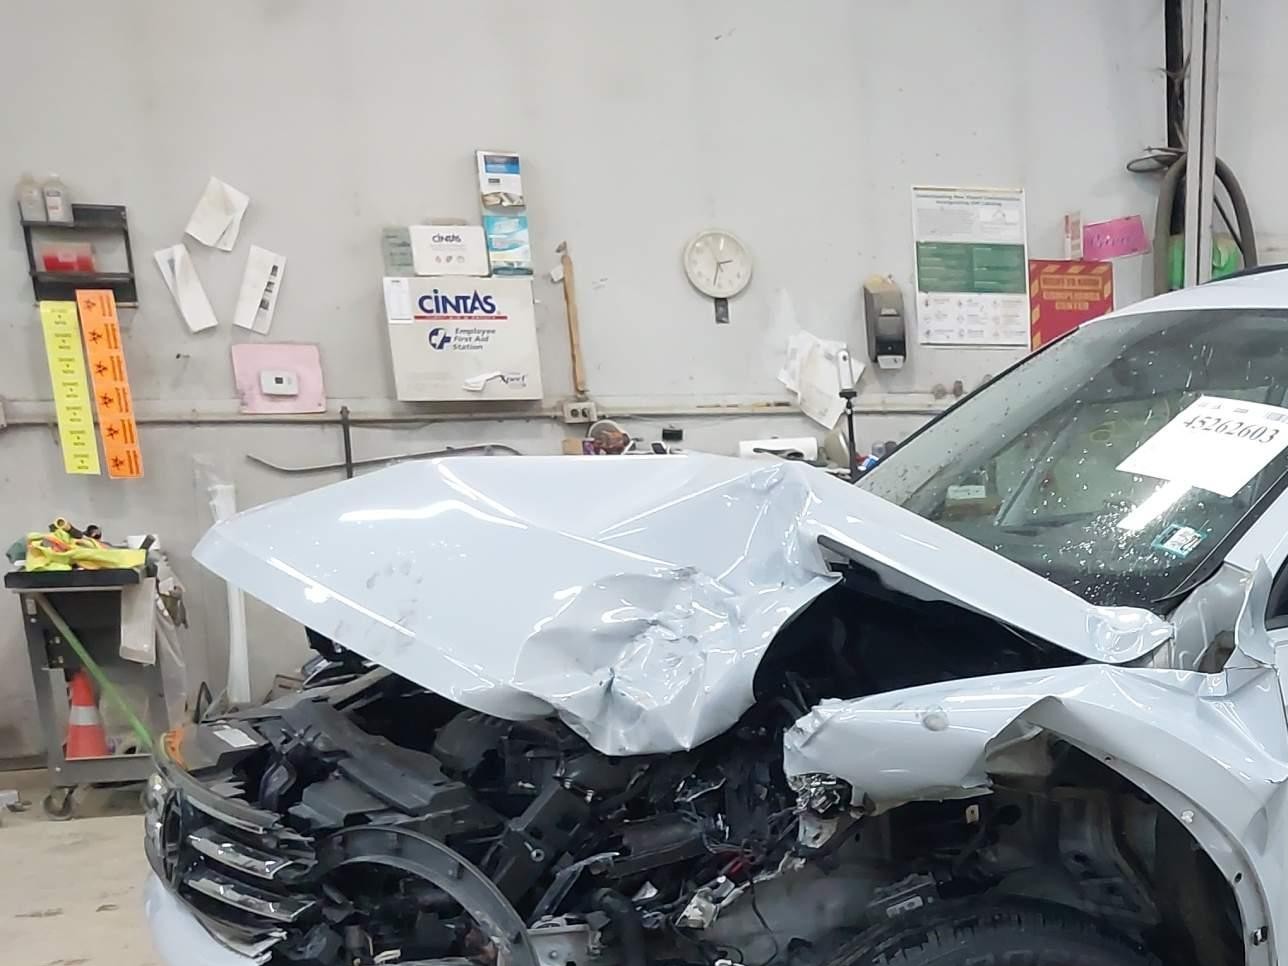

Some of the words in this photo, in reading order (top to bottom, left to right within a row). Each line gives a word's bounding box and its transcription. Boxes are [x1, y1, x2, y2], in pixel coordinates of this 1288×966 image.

[455, 328, 496, 336] Employee
[453, 335, 472, 343] First
[452, 342, 484, 350] Station
[1183, 415, 1280, 444] 45262603
